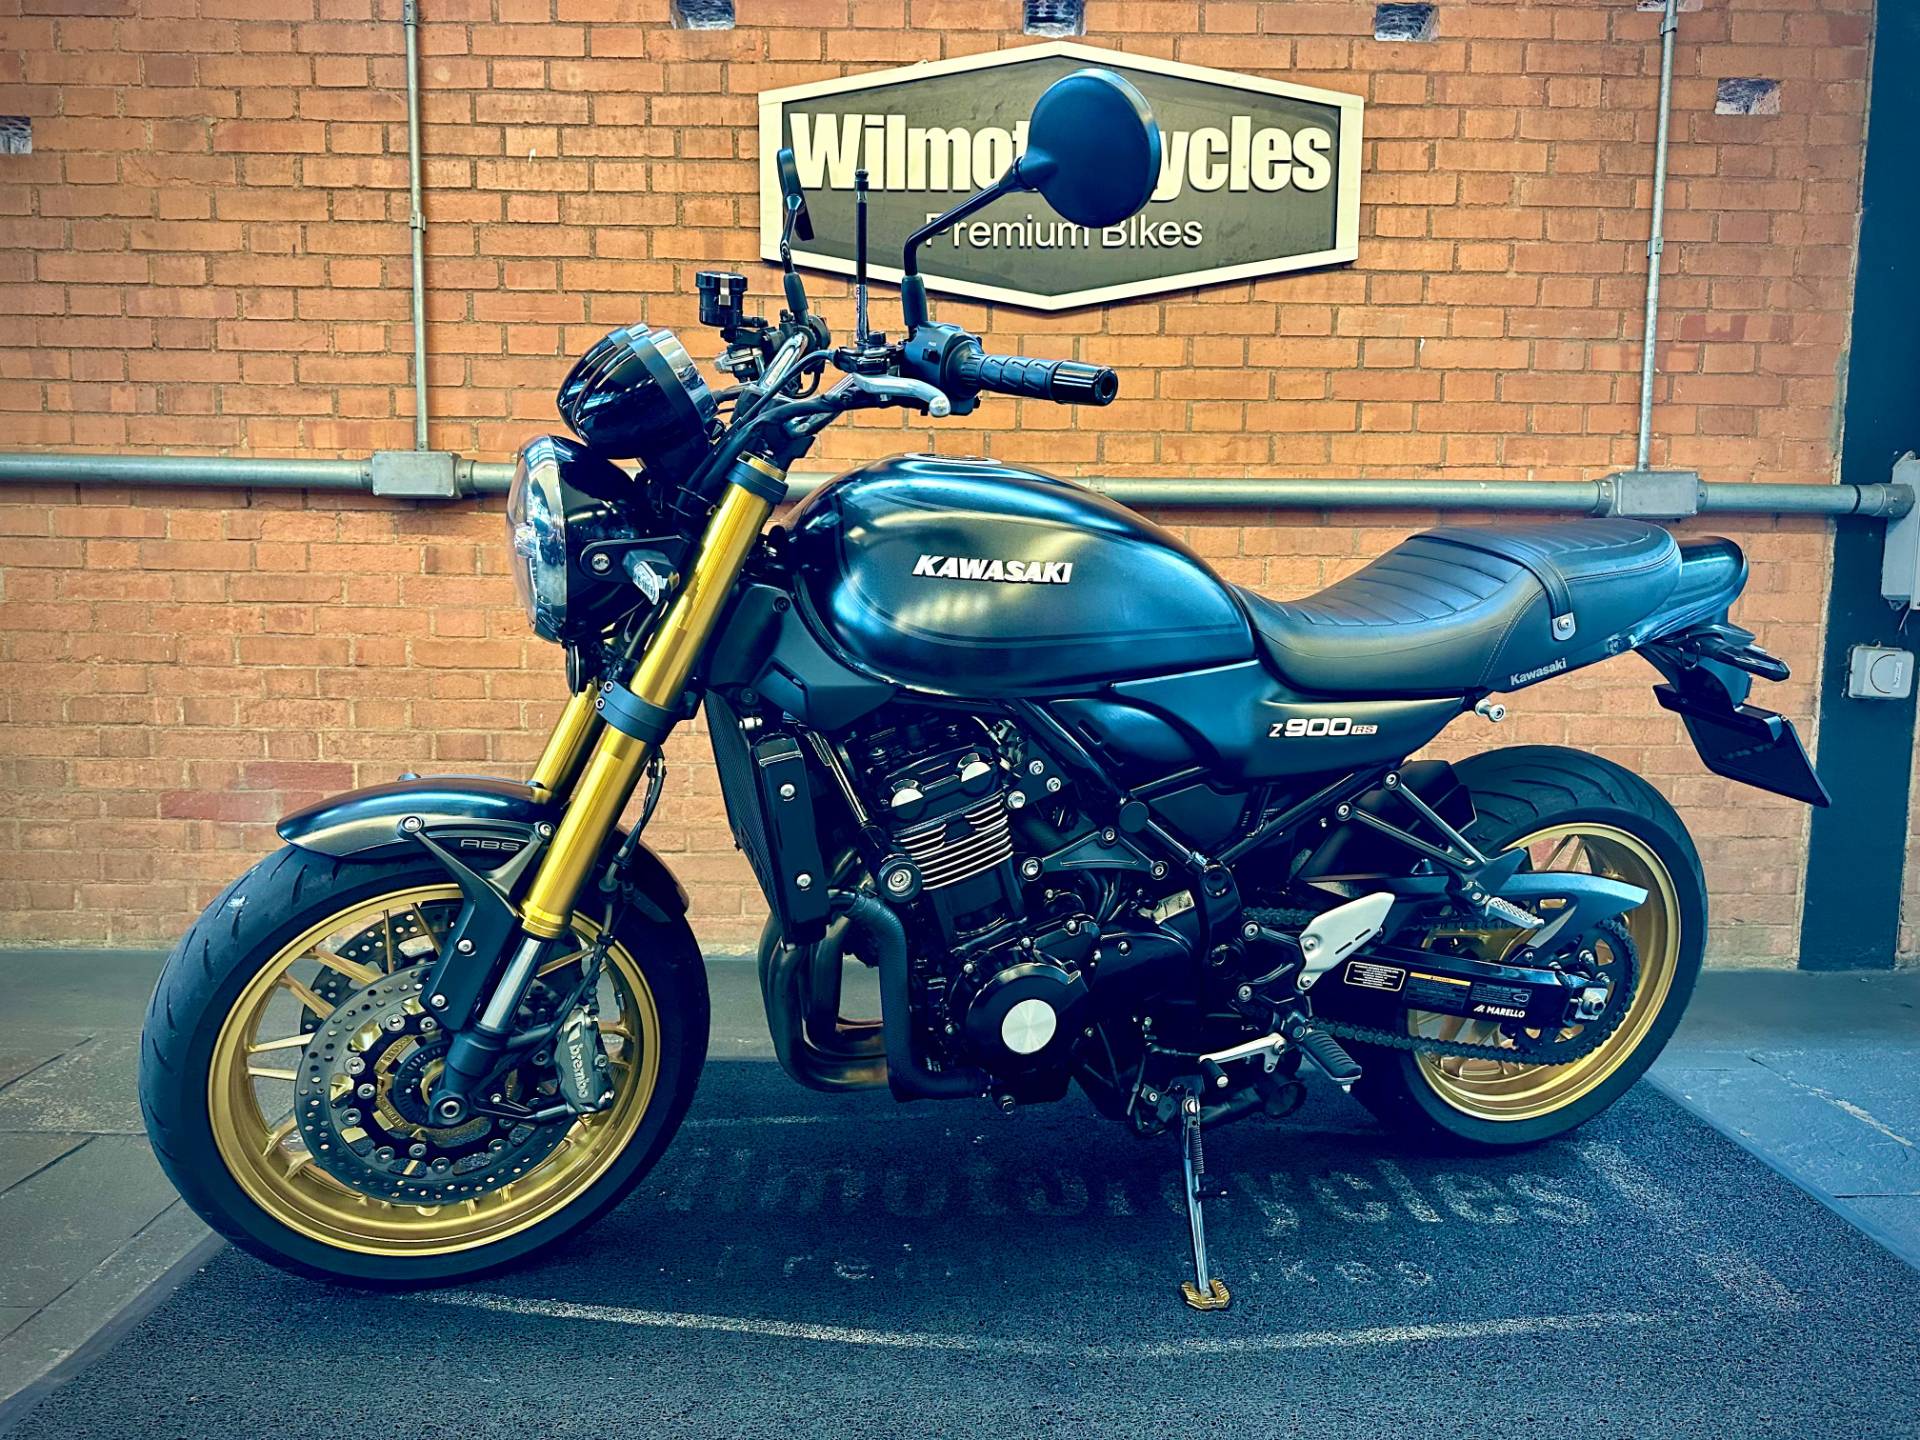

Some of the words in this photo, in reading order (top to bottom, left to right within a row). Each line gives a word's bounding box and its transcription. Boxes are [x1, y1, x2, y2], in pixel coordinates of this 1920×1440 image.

[912, 554, 1073, 584] KAWASAKI
[1510, 657, 1567, 686] Kawasaki
[460, 839, 520, 851] ABS
[1486, 1005, 1526, 1019] MARELLO
[569, 1043, 590, 1099] brembo
